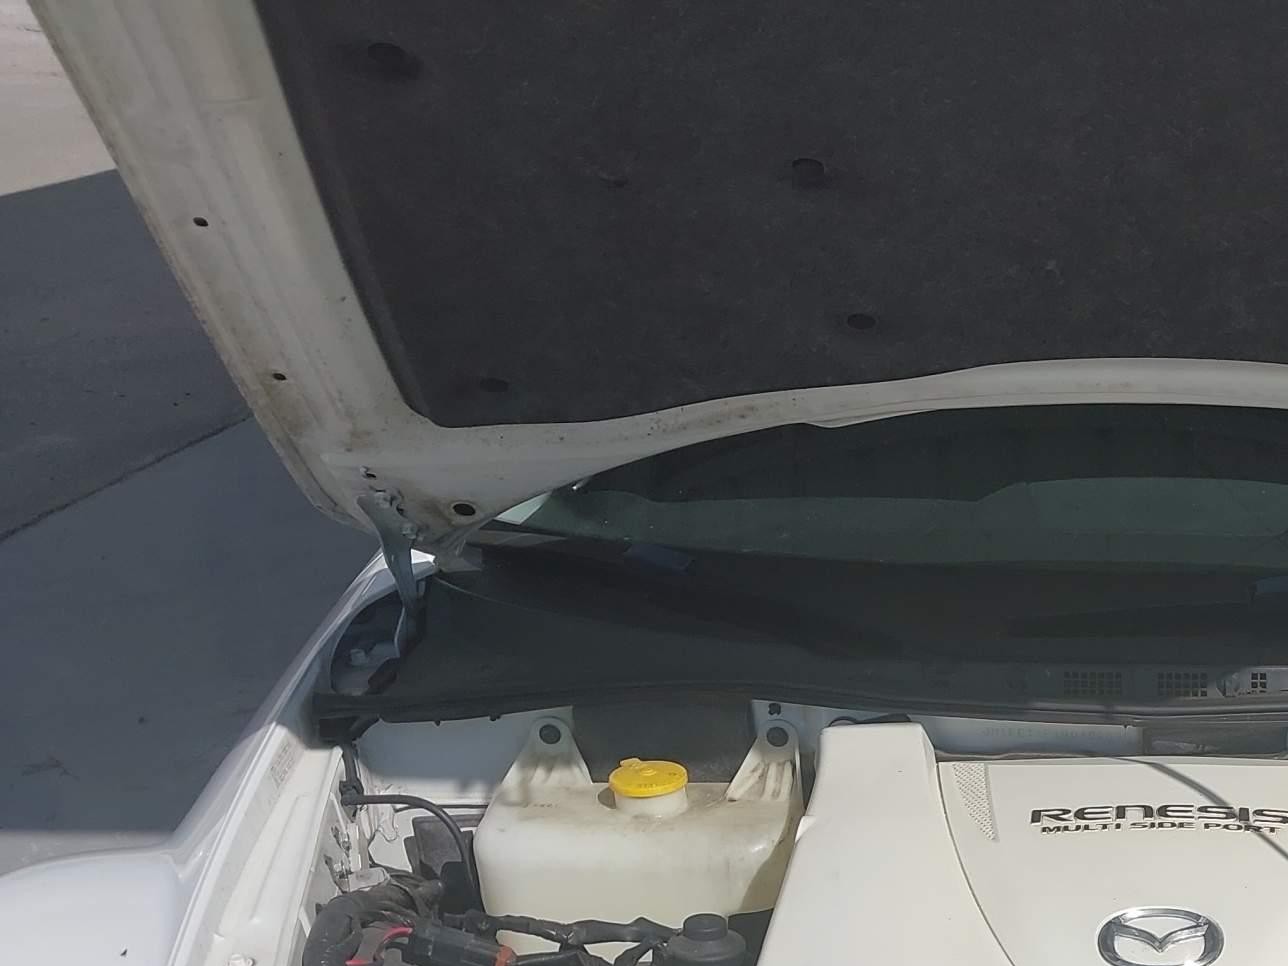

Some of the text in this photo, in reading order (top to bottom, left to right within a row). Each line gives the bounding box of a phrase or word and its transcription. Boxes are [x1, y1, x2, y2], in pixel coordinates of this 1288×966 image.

[1041, 821, 1282, 834] MULTI SIDE PORT
